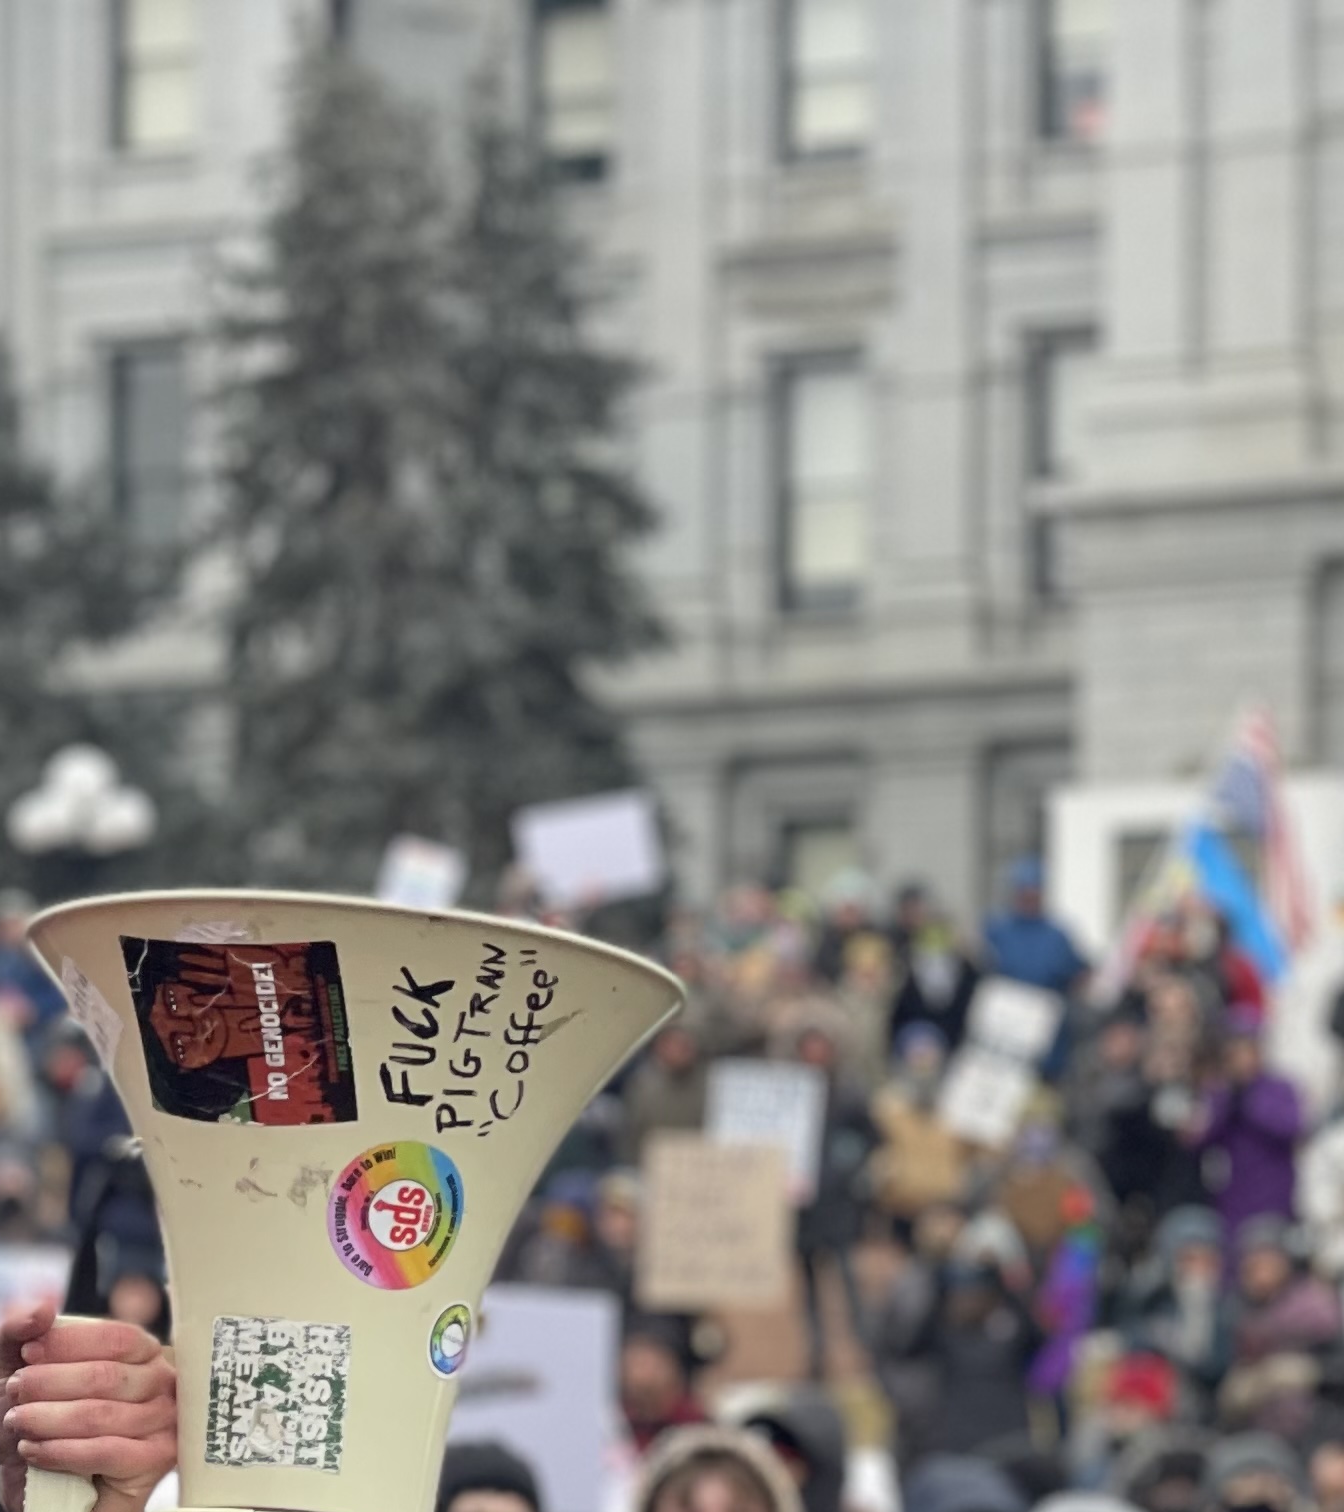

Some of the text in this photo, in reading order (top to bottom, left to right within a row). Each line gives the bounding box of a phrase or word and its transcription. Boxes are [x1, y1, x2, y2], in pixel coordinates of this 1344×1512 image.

[251, 961, 290, 1100] NO GENOCIDE!
[379, 966, 456, 1107] FUCK
[435, 1048, 482, 1134] PIG
[341, 1168, 362, 1192] Dare
[360, 1158, 374, 1171] to
[372, 1147, 397, 1164] Win!
[373, 1185, 426, 1246] sds
[342, 1242, 355, 1257] to
[350, 1254, 374, 1278] Dare
[263, 1322, 298, 1375] BY
[214, 1325, 237, 1463] NECESSARY
[230, 1319, 263, 1461] MEANS
[298, 1326, 337, 1468] RESIST
